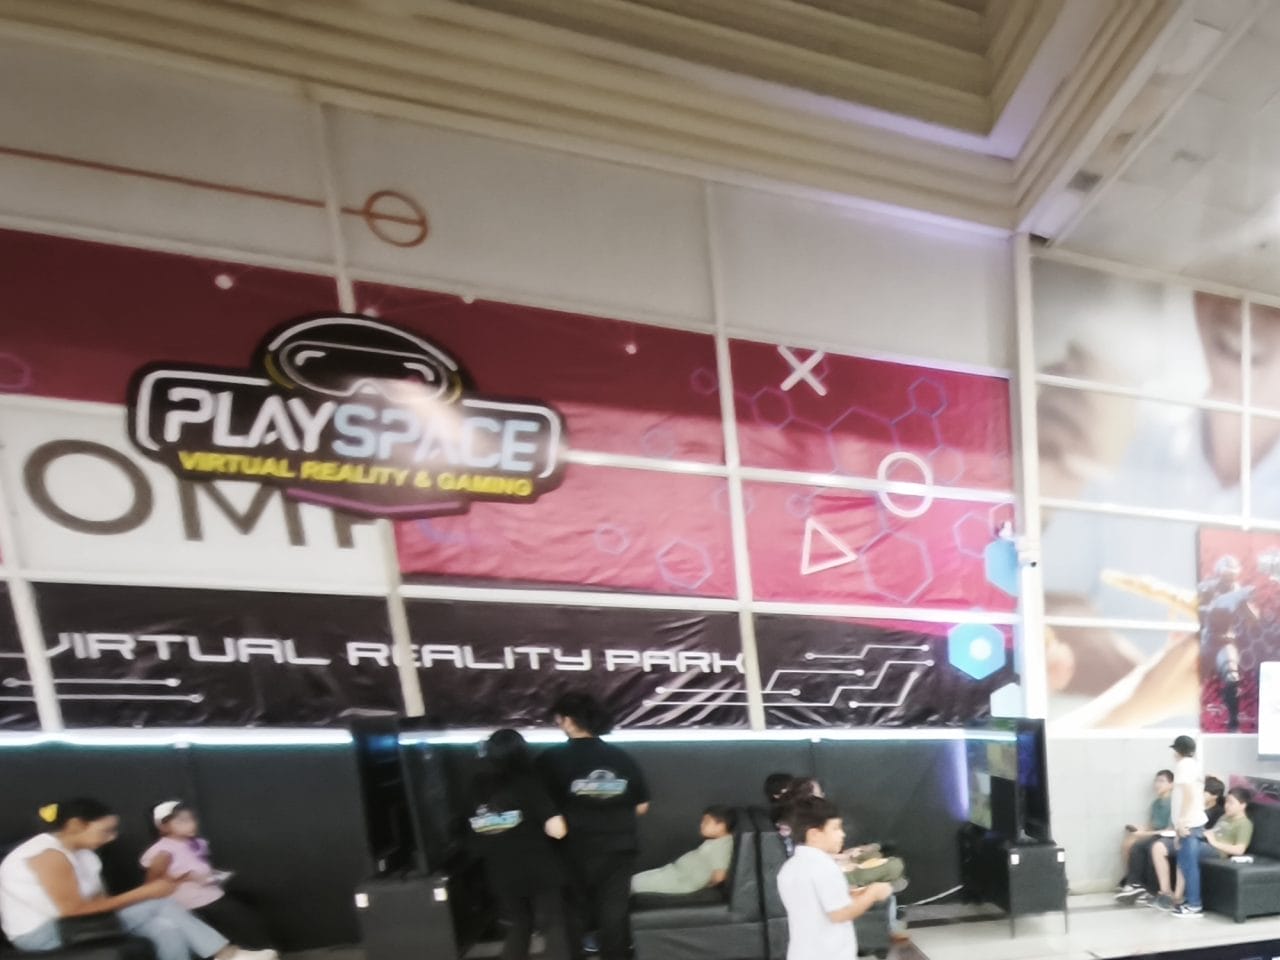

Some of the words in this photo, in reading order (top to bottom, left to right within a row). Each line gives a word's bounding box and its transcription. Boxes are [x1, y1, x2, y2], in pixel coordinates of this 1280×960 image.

[178, 450, 296, 479] VIRTUAL
[301, 461, 407, 487] REALITY
[412, 466, 432, 489] &
[436, 471, 534, 497] GAMING
[604, 649, 746, 675] PARK
